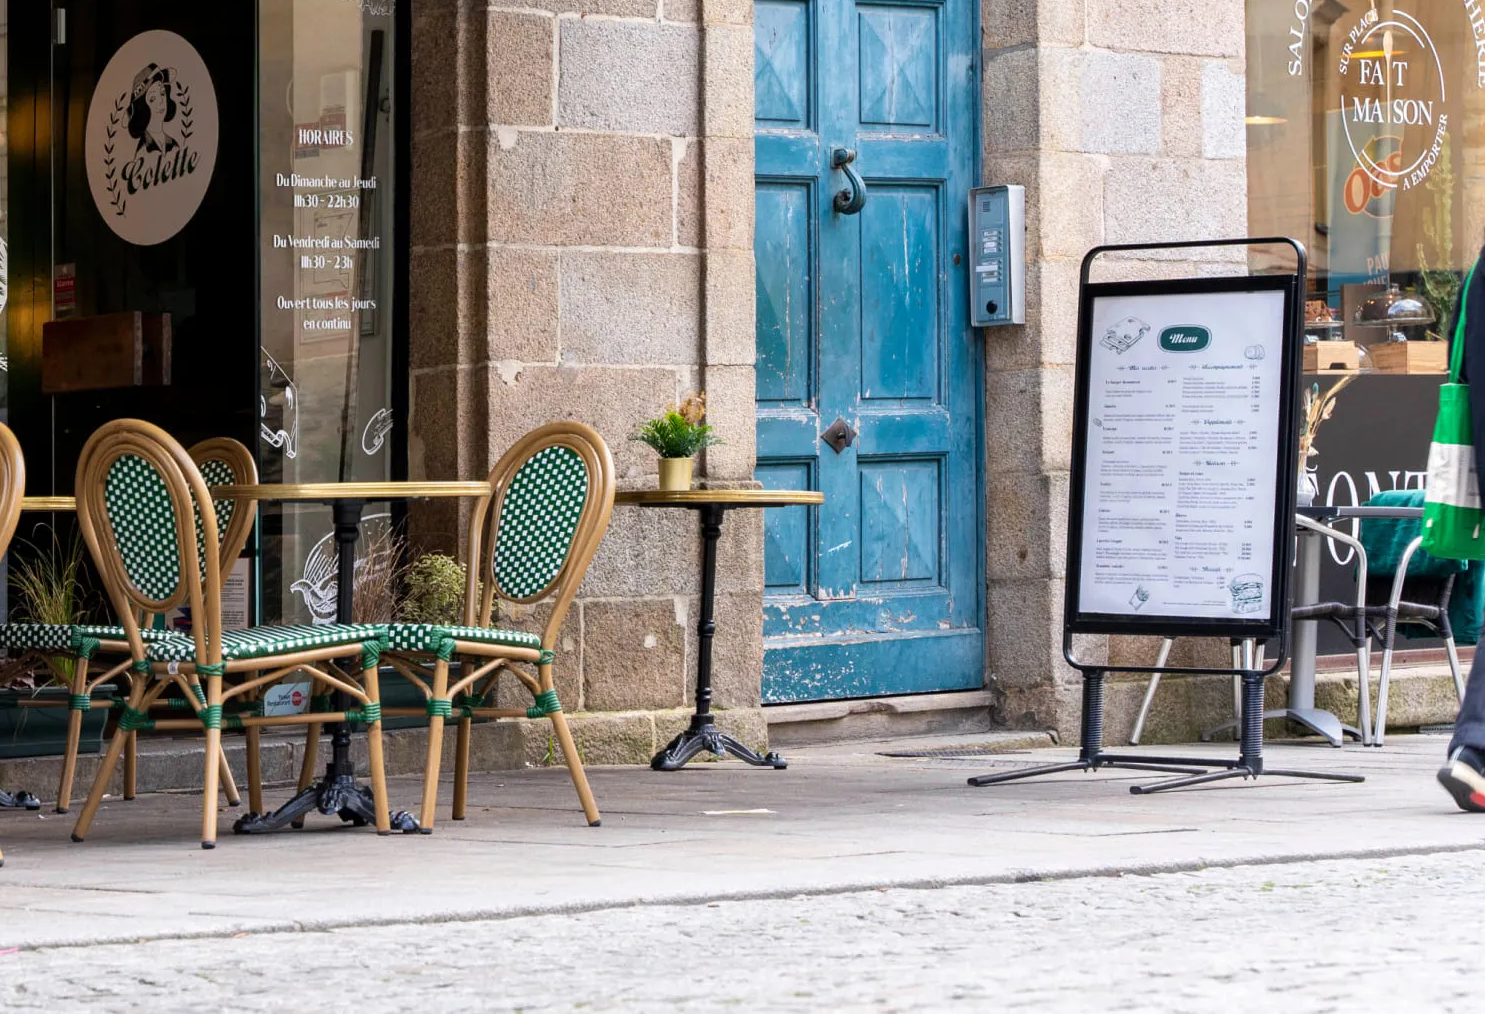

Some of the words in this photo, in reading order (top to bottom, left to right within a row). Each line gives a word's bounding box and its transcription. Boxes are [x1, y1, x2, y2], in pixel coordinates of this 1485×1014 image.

[1339, 42, 1354, 74] SUR
[299, 128, 354, 146] HORAIRES
[1410, 113, 1448, 185] EMPORTER
[121, 146, 201, 195] Colette
[276, 173, 289, 187] Du
[291, 173, 337, 188] Dimanche
[338, 180, 351, 188] au
[352, 175, 377, 189] Jeudi
[294, 194, 318, 208] 11h30
[327, 194, 359, 208] 22h30
[273, 234, 287, 248] Du
[288, 234, 330, 248] Vendredi
[344, 236, 380, 249] Samedi
[301, 255, 325, 269] 11h30
[334, 255, 353, 269] 23h
[277, 295, 310, 309] Ouvert
[313, 297, 333, 309] tous
[335, 296, 349, 309] les
[351, 297, 377, 312] jours
[303, 321, 315, 330] en
[316, 317, 351, 330] continu
[1169, 333, 1198, 344] Menu
